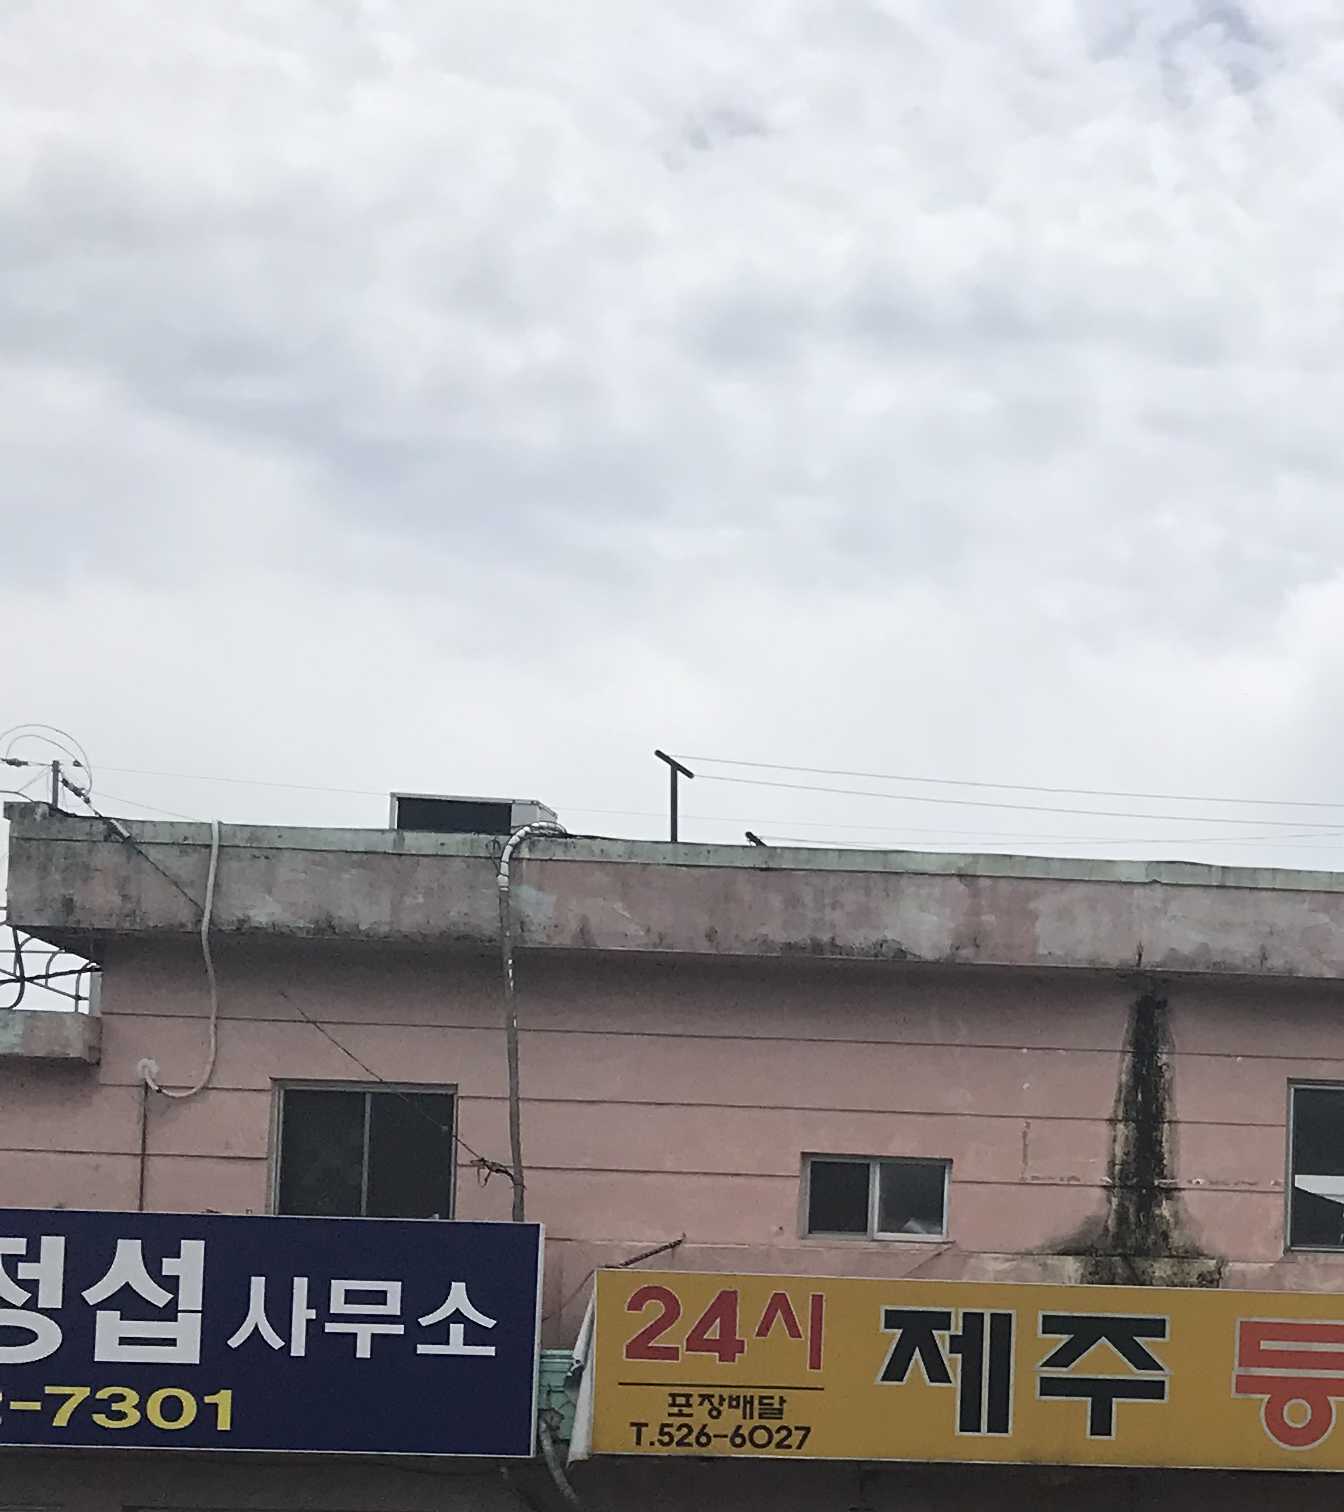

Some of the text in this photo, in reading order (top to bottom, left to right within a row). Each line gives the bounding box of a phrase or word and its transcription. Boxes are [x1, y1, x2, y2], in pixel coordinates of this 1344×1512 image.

[226, 1275, 498, 1359] 사무소
[622, 1284, 827, 1373] 24시
[873, 1304, 1173, 1440] 제주
[0, 1386, 234, 1431] -7301
[630, 1421, 812, 1451] T.526-6027
[666, 1392, 788, 1421] 포장배달
